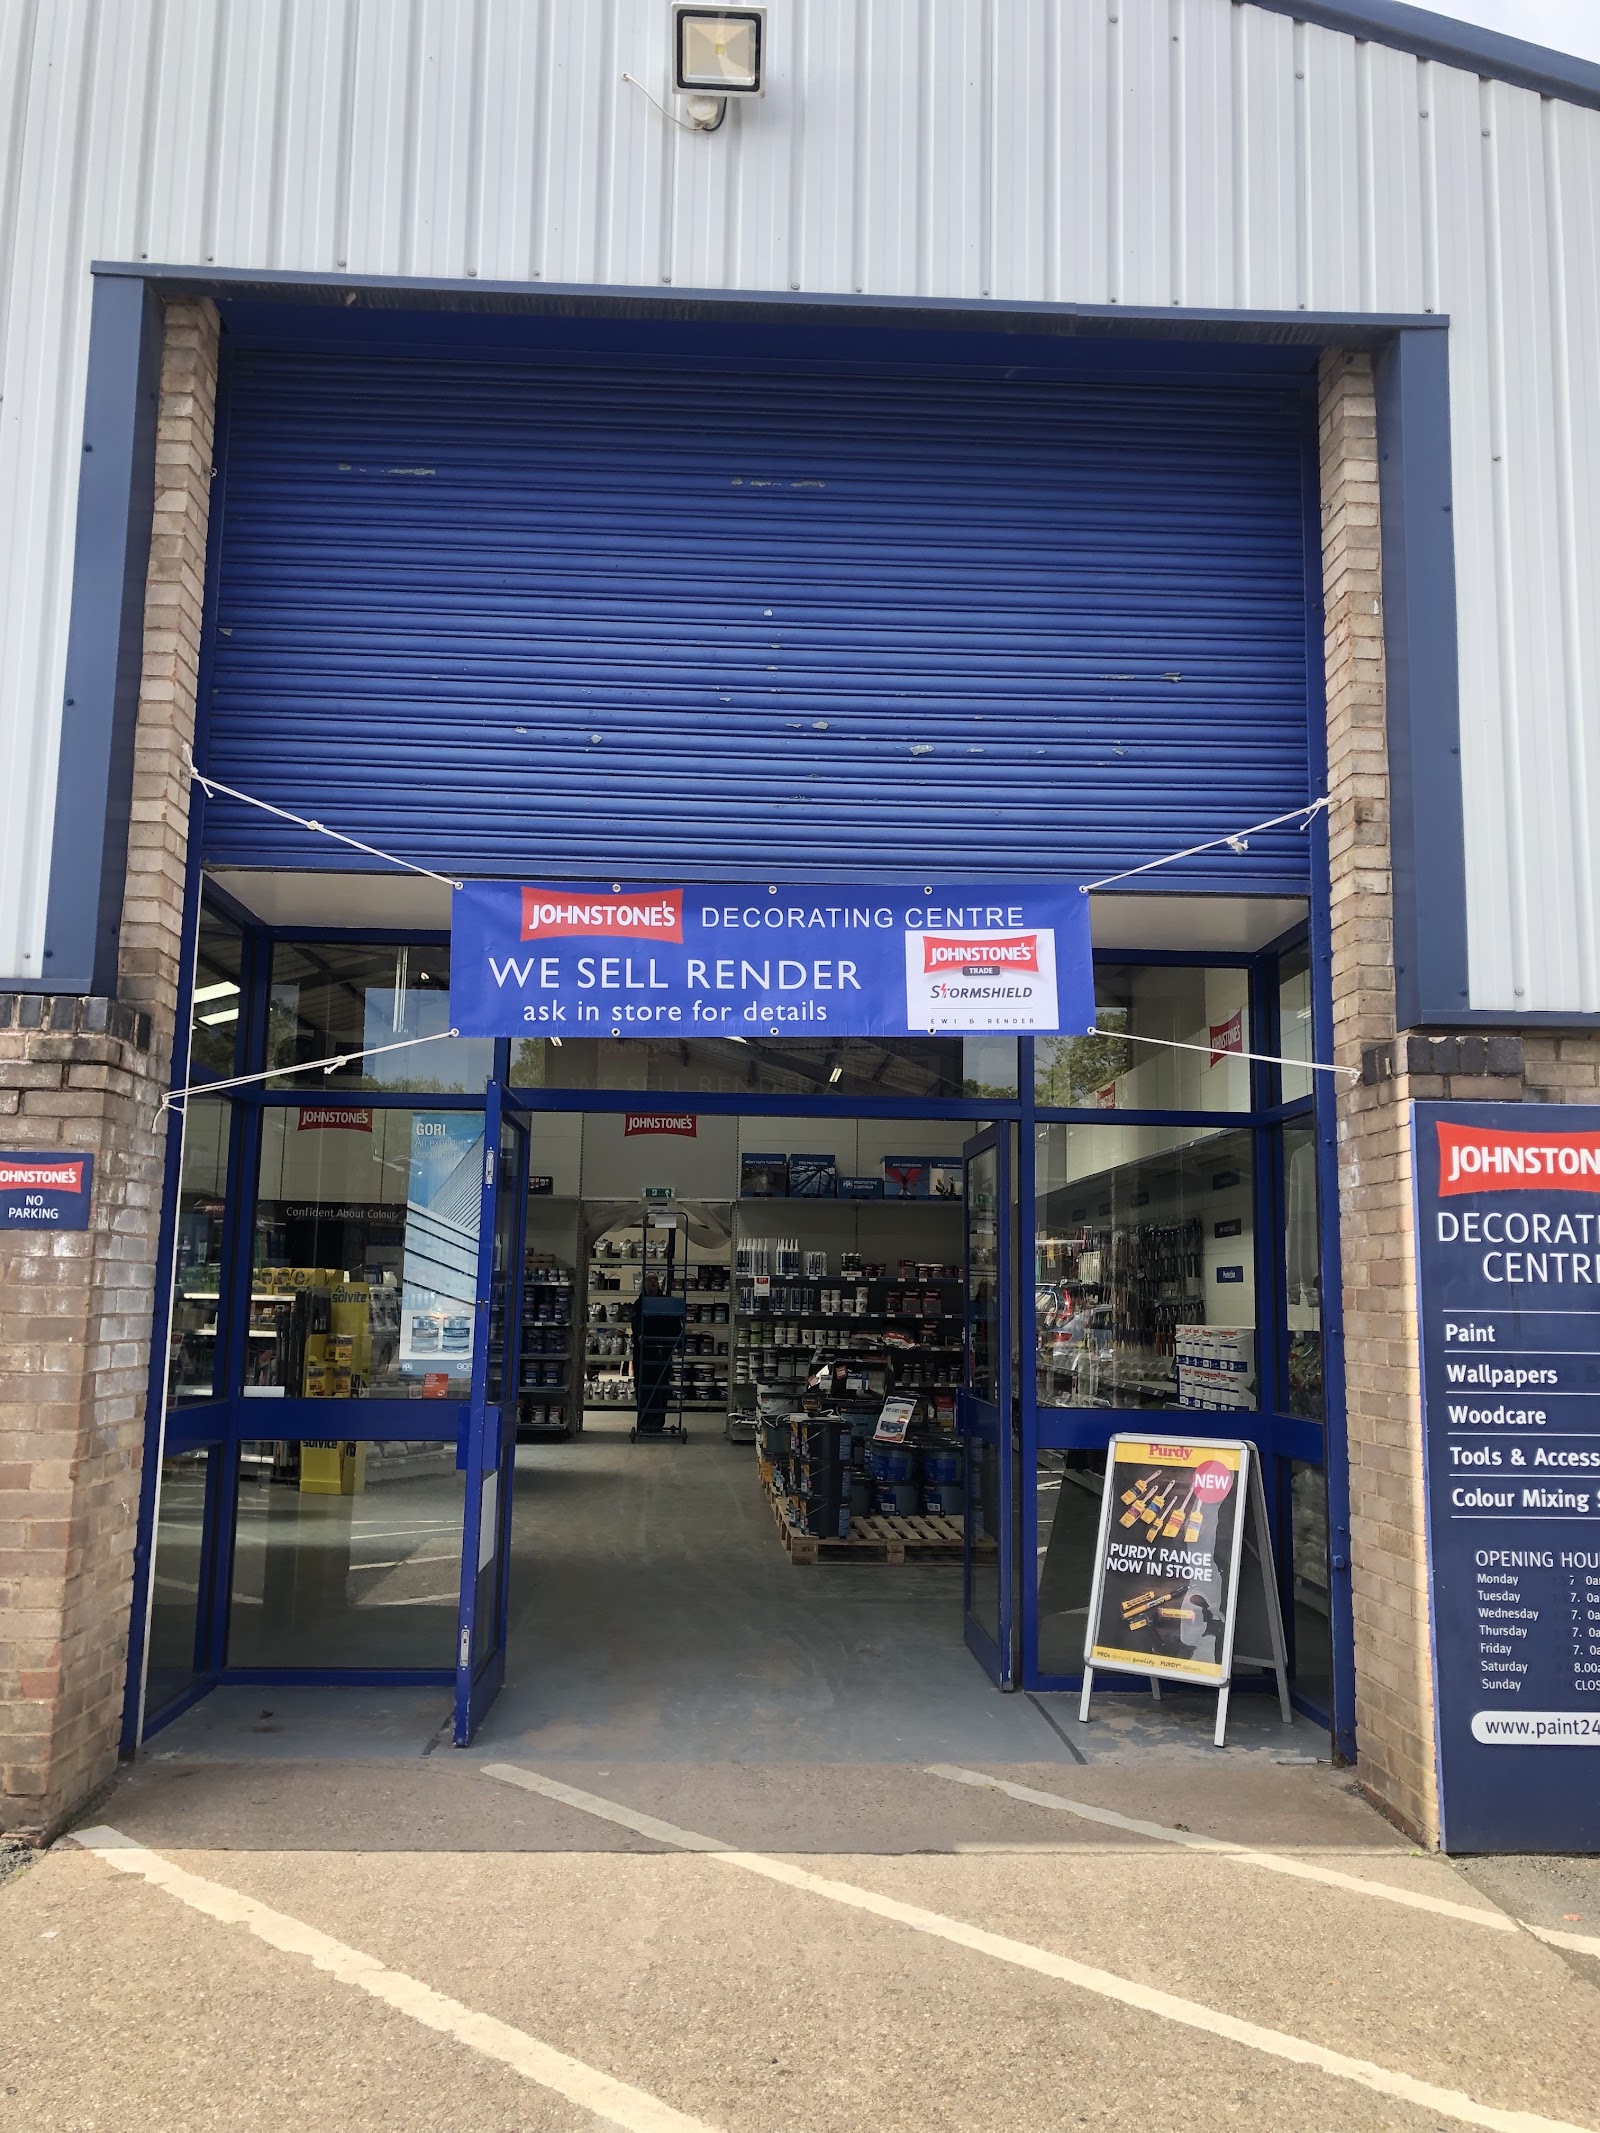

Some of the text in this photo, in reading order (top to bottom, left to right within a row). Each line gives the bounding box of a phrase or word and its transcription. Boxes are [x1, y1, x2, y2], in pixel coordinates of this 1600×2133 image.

[528, 900, 1024, 930] JOHNSTONE'S DECORATING CENTRE
[929, 942, 1033, 966] JOHNSTONE'S
[488, 957, 863, 990] WE SELL RENDER
[930, 983, 1033, 999] STORMSHIELD
[523, 1000, 828, 1022] ask in store for details
[301, 1108, 369, 1126] JOHNSTONE'S
[628, 1114, 693, 1131] JOHNSTONE'S
[416, 1123, 446, 1136] GORI
[25, 1195, 44, 1206] NO
[8, 1207, 59, 1219] PARKING
[286, 1206, 396, 1219] Confident About Colour
[331, 1291, 368, 1303] solvite
[1445, 1323, 1496, 1342] Paint
[1446, 1363, 1559, 1388] Wallpapers
[1448, 1405, 1547, 1425] Woodcare
[1149, 1443, 1194, 1461] Purdy
[1450, 1446, 1600, 1467] Tools & Access
[1194, 1473, 1230, 1490] NEW
[1452, 1487, 1515, 1508] Colour
[1522, 1487, 1590, 1513] Mixing
[1110, 1542, 1212, 1567] PURDY RANGE
[1475, 1550, 1554, 1568] OPENING
[1106, 1557, 1213, 1583] NOW IN STORE
[1477, 1573, 1519, 1586] Monday
[1477, 1590, 1521, 1603] Tuesday
[1478, 1607, 1539, 1621] Wednesday
[1479, 1624, 1528, 1638] Thursday
[1480, 1642, 1512, 1656] Friday
[1481, 1660, 1528, 1674] Saturday
[1482, 1677, 1522, 1691] Sunday
[1485, 1717, 1600, 1738] www.paint24
